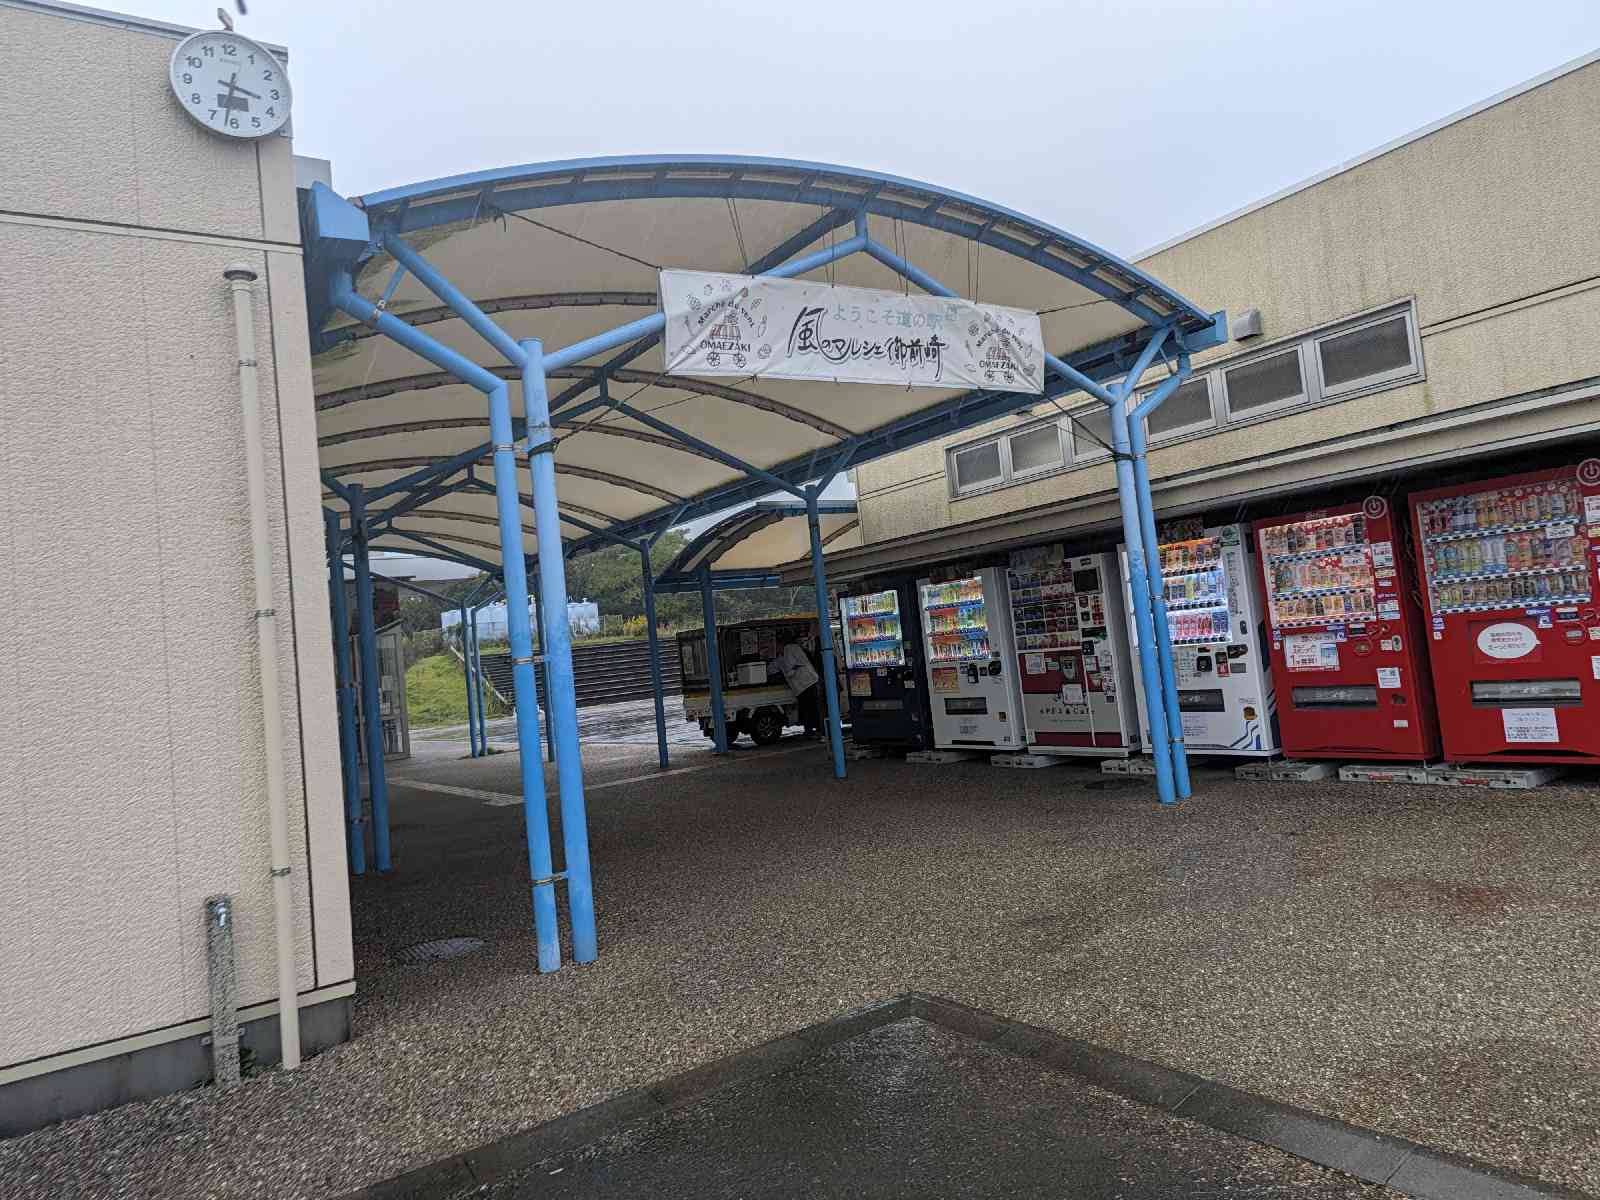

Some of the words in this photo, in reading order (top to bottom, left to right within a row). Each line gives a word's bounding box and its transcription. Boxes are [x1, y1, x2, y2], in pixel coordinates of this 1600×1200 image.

[202, 46, 214, 57] 11
[222, 44, 237, 56] 12
[186, 56, 202, 68] 10
[248, 54, 255, 64] 1
[183, 73, 192, 84] 9
[264, 70, 272, 81] 2
[192, 93, 201, 104] 8
[270, 89, 280, 100] 3
[208, 109, 218, 120] 7
[266, 107, 275, 118] 4
[230, 118, 239, 129] 6
[251, 117, 261, 128] 5
[699, 339, 751, 352] OMAEZAKI
